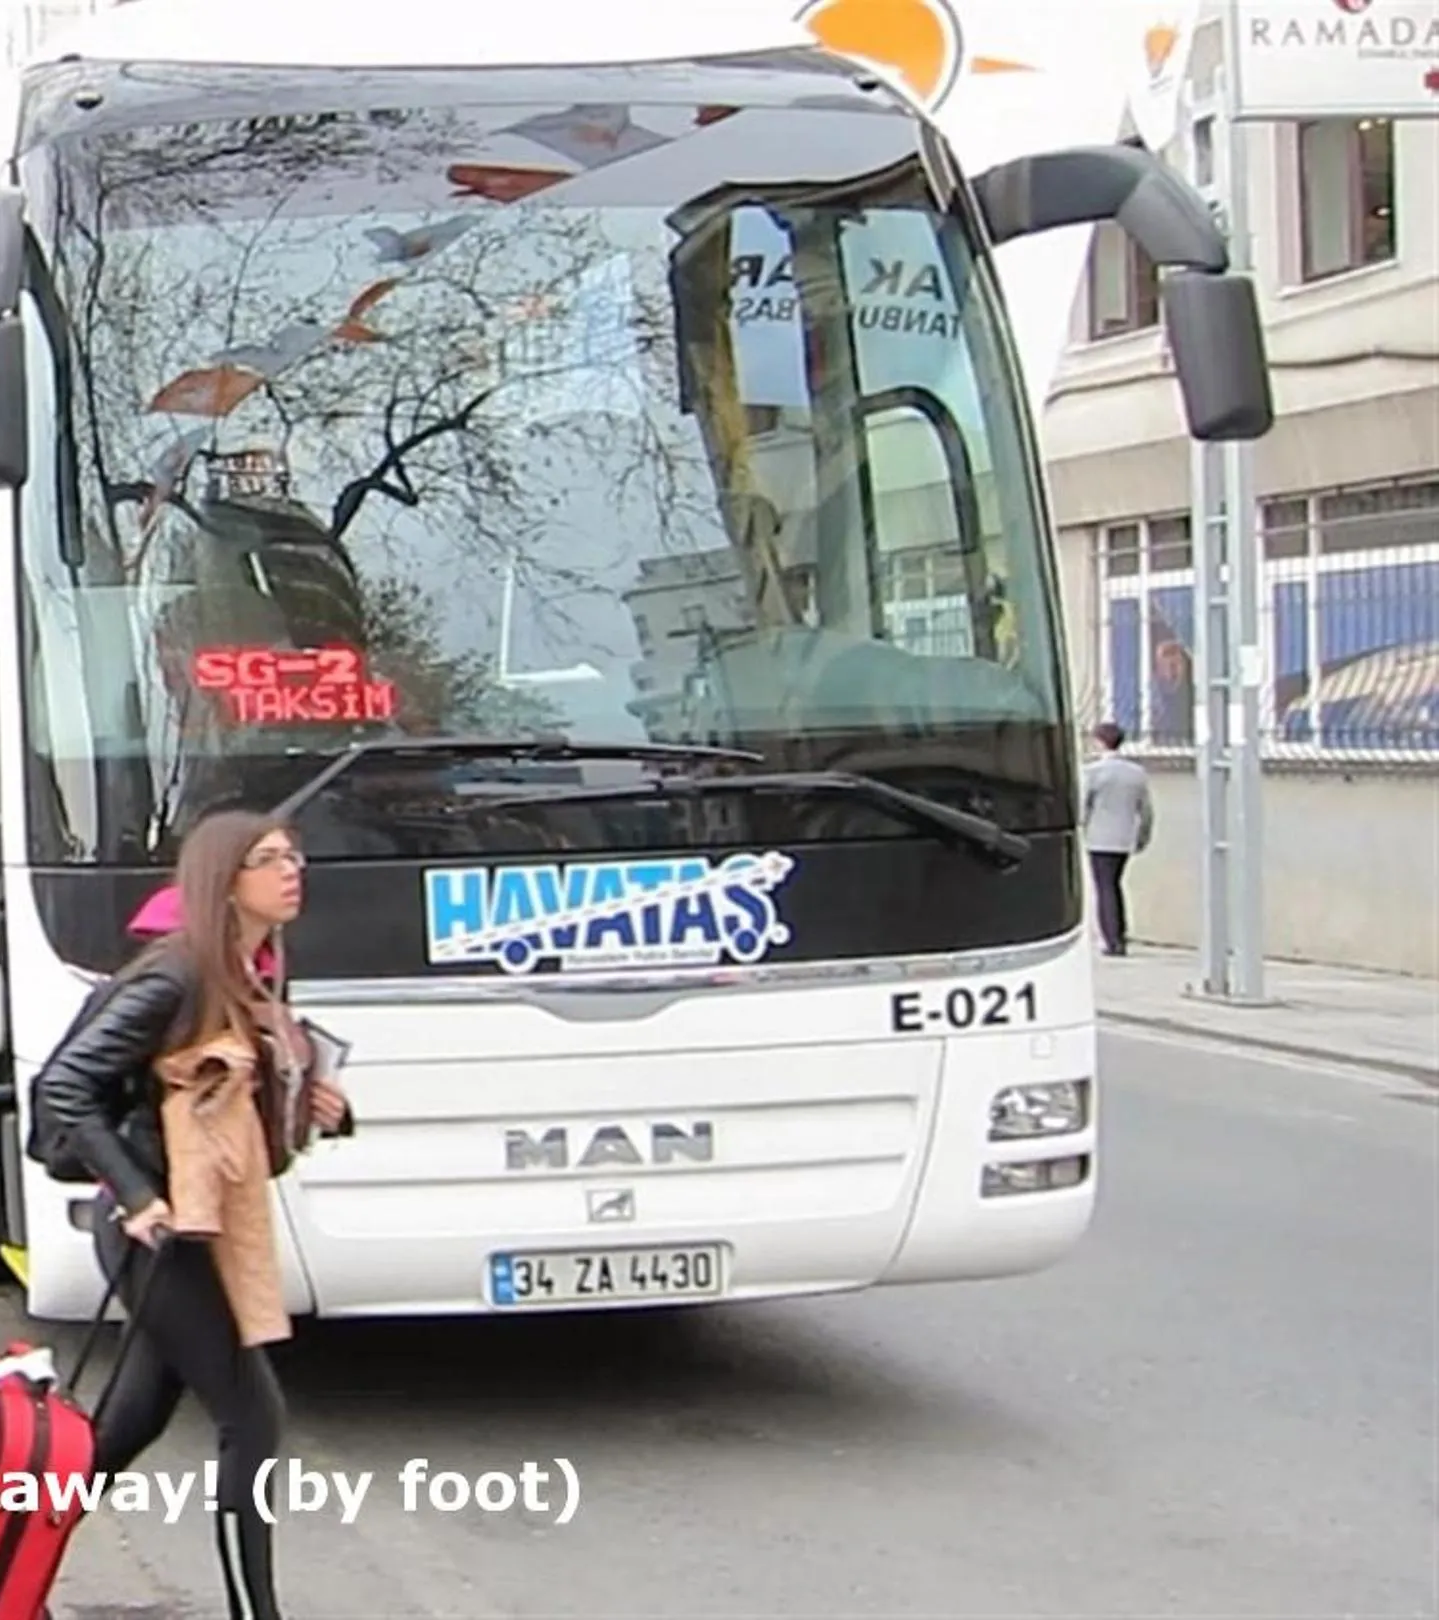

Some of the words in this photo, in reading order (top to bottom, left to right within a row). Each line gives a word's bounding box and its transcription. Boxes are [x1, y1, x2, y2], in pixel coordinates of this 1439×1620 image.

[1250, 17, 1439, 46] RAMADA
[195, 649, 359, 688] SG-2
[891, 981, 1037, 1032] E-021
[505, 1121, 713, 1170] MAN
[514, 1260, 554, 1296] 34
[574, 1255, 615, 1293] ZA
[629, 1252, 711, 1290] 4430
